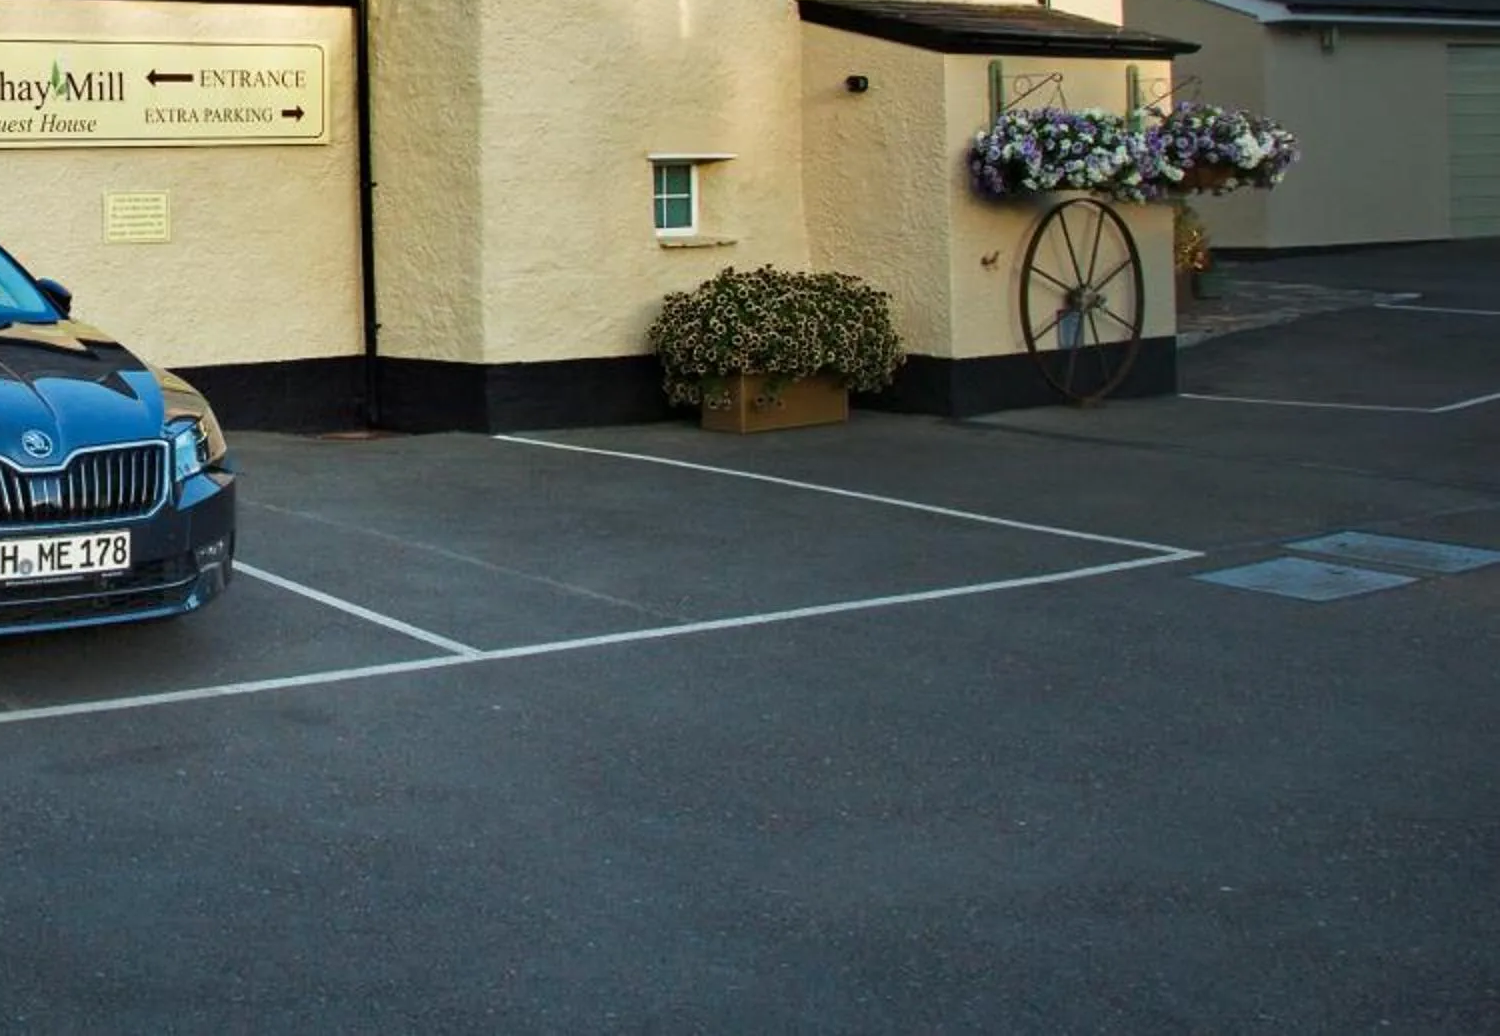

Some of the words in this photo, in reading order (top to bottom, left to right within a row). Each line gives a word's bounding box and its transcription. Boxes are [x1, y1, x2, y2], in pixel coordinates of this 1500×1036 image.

[65, 70, 125, 102] Mill
[199, 69, 307, 89] ENTRANCE
[40, 113, 97, 134] House
[144, 107, 200, 124] EXTRA
[203, 106, 274, 124] PARKING
[38, 541, 72, 572] ME
[79, 536, 127, 567] 178
